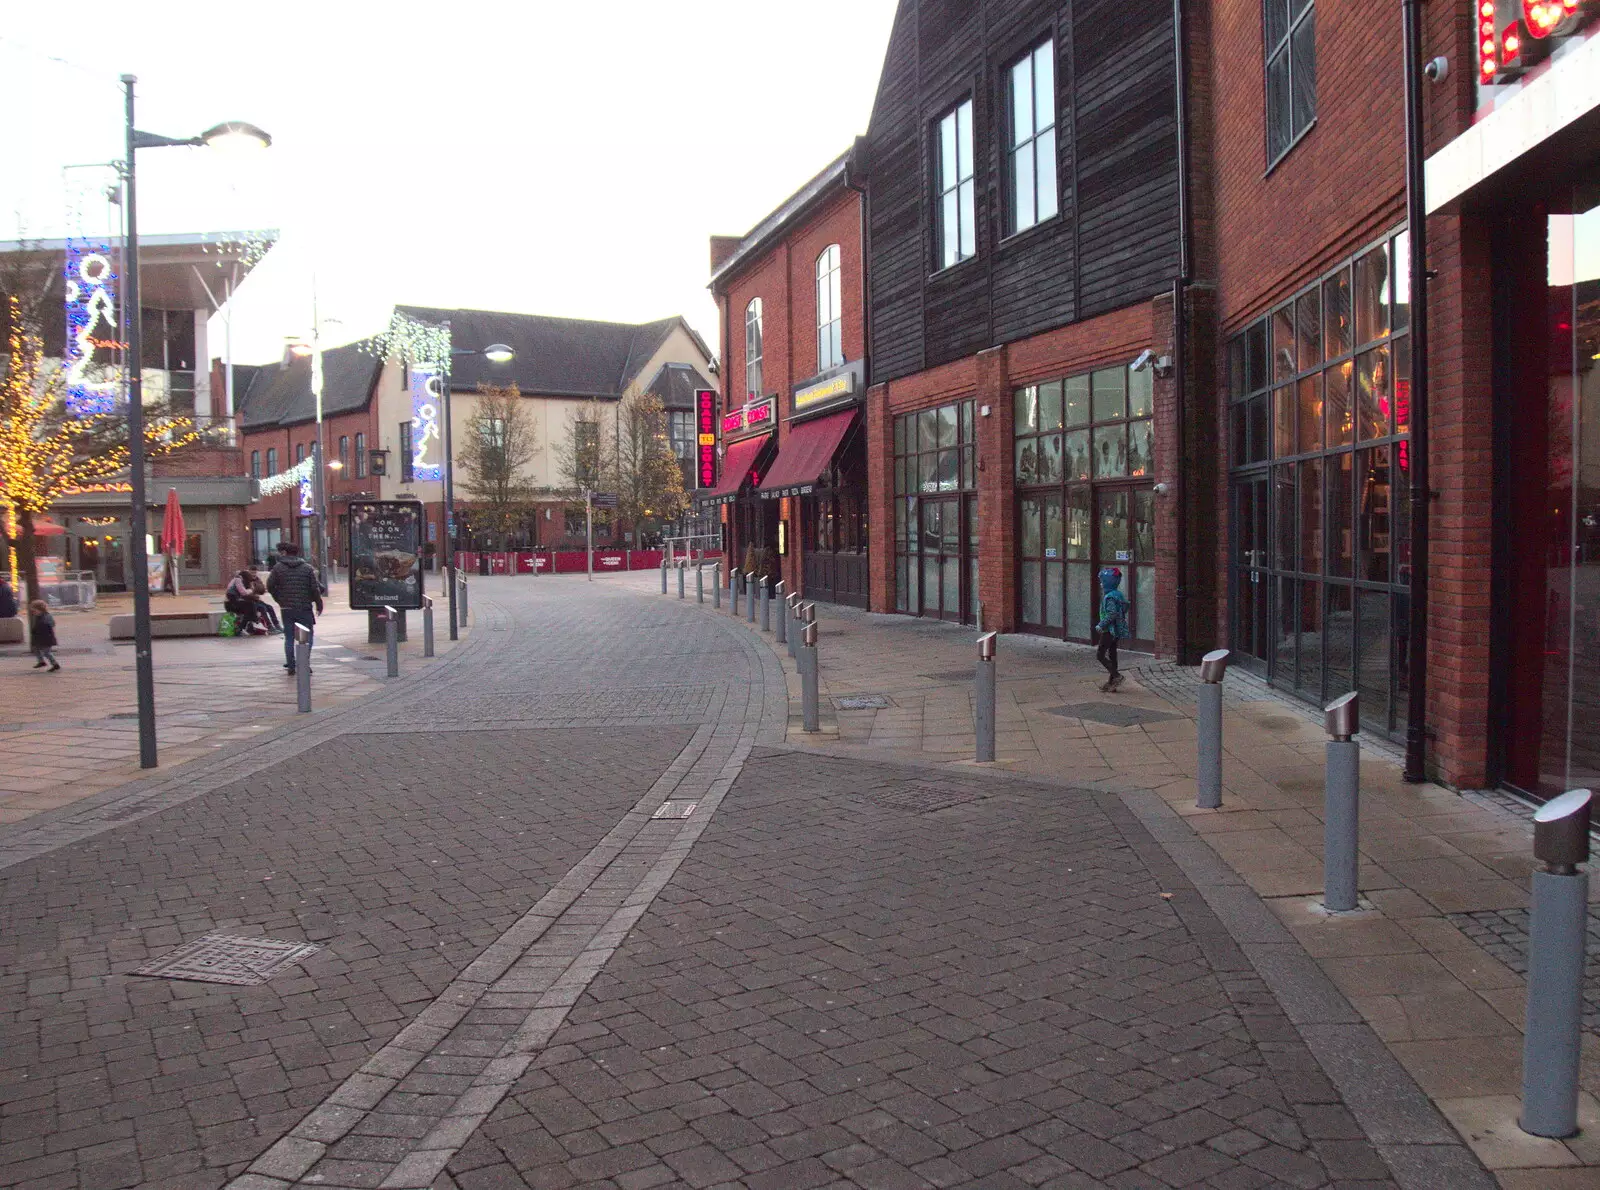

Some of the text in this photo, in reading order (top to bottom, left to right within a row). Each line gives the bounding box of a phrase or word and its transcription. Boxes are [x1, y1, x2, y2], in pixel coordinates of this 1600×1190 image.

[701, 391, 712, 433] COAST
[747, 405, 769, 424] COAST
[702, 446, 713, 487] COAST
